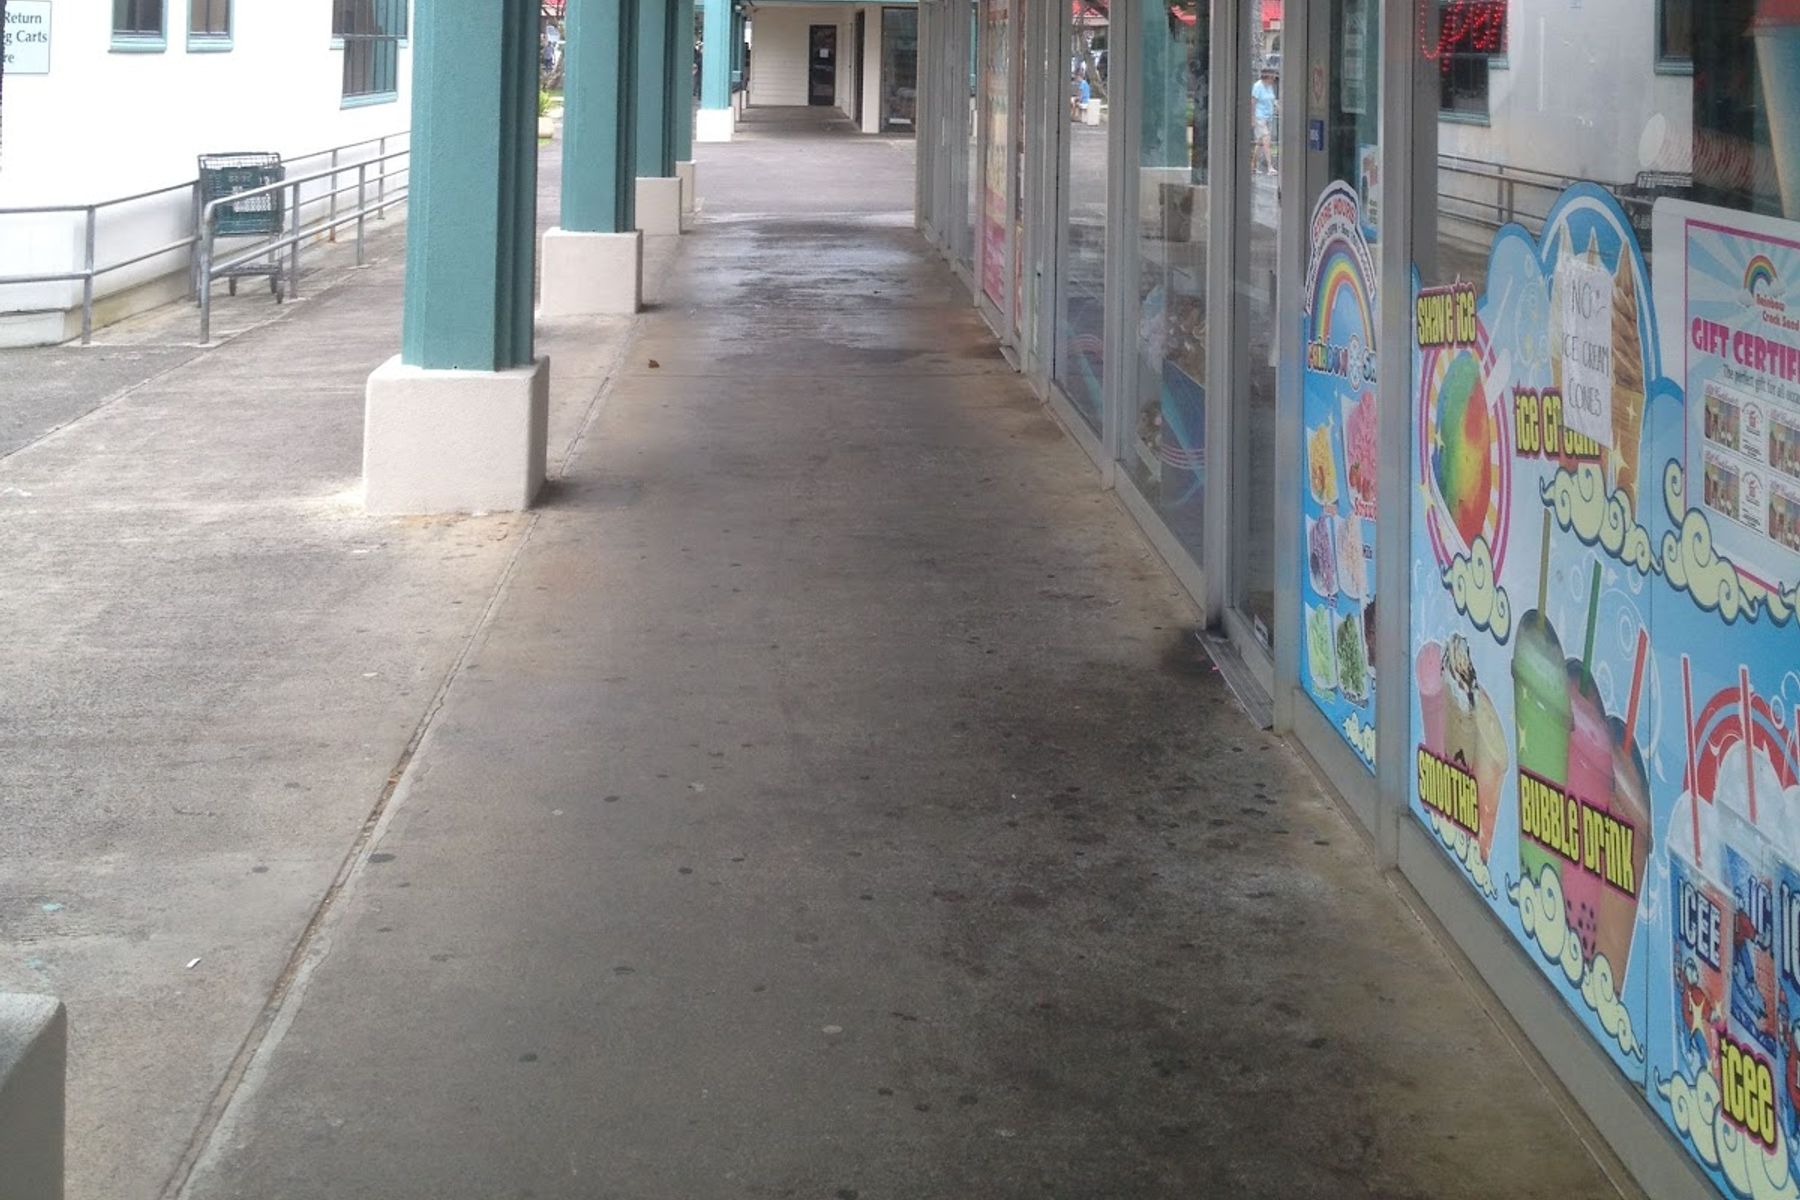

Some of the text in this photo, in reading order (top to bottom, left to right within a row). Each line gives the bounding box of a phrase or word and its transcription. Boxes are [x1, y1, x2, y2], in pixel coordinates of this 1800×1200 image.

[16, 29, 48, 43] Carts
[1571, 280, 1592, 320] NO
[1562, 332, 1610, 378] ICE CREAM
[1692, 317, 1800, 384] GIFT CERTIF
[1678, 877, 1722, 973] ICEE
